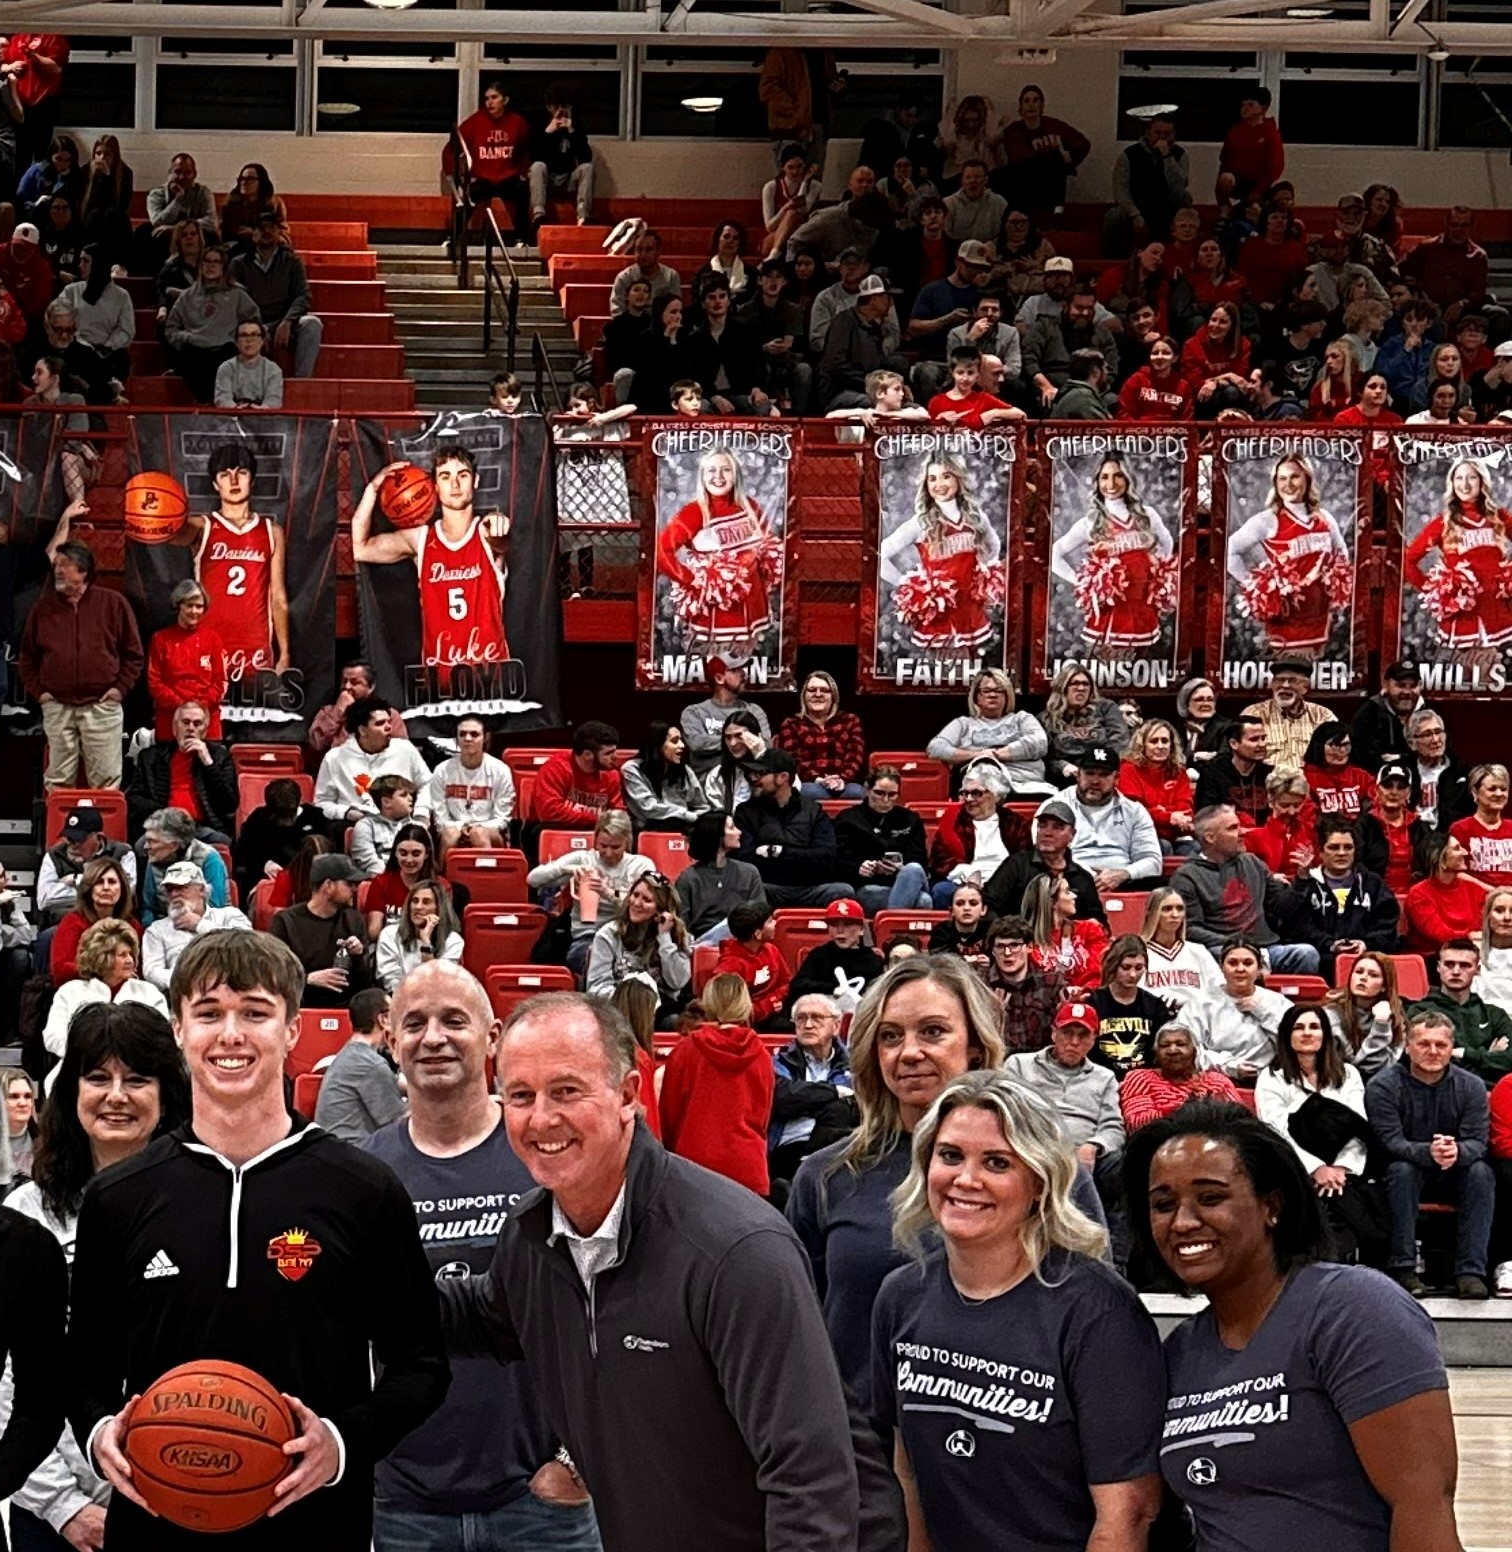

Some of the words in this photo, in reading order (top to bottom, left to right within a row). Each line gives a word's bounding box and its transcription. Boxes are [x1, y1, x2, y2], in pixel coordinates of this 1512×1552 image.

[1221, 436, 1364, 466] CHEERLEADERS
[226, 566, 247, 597] 2
[447, 587, 468, 621] 5
[425, 626, 501, 667] Luke
[404, 658, 528, 707] FLOYD
[661, 653, 769, 686] MAN
[895, 656, 983, 687] FAITH
[1223, 660, 1348, 690] HOHER
[1418, 663, 1507, 692] MILLS
[437, 1194, 506, 1213] SUPPORT
[419, 1212, 509, 1243] muniti
[896, 1342, 931, 1361] PROUD
[932, 1349, 951, 1364] TO
[950, 1351, 1020, 1382] SUPPORT
[1020, 1367, 1056, 1392] OUR
[1253, 1372, 1287, 1392] OUR
[896, 1360, 1055, 1424] Communities!
[150, 1390, 270, 1434] SPALDING
[1163, 1393, 1289, 1440] mmunities!
[169, 1448, 233, 1470] KHSAA
